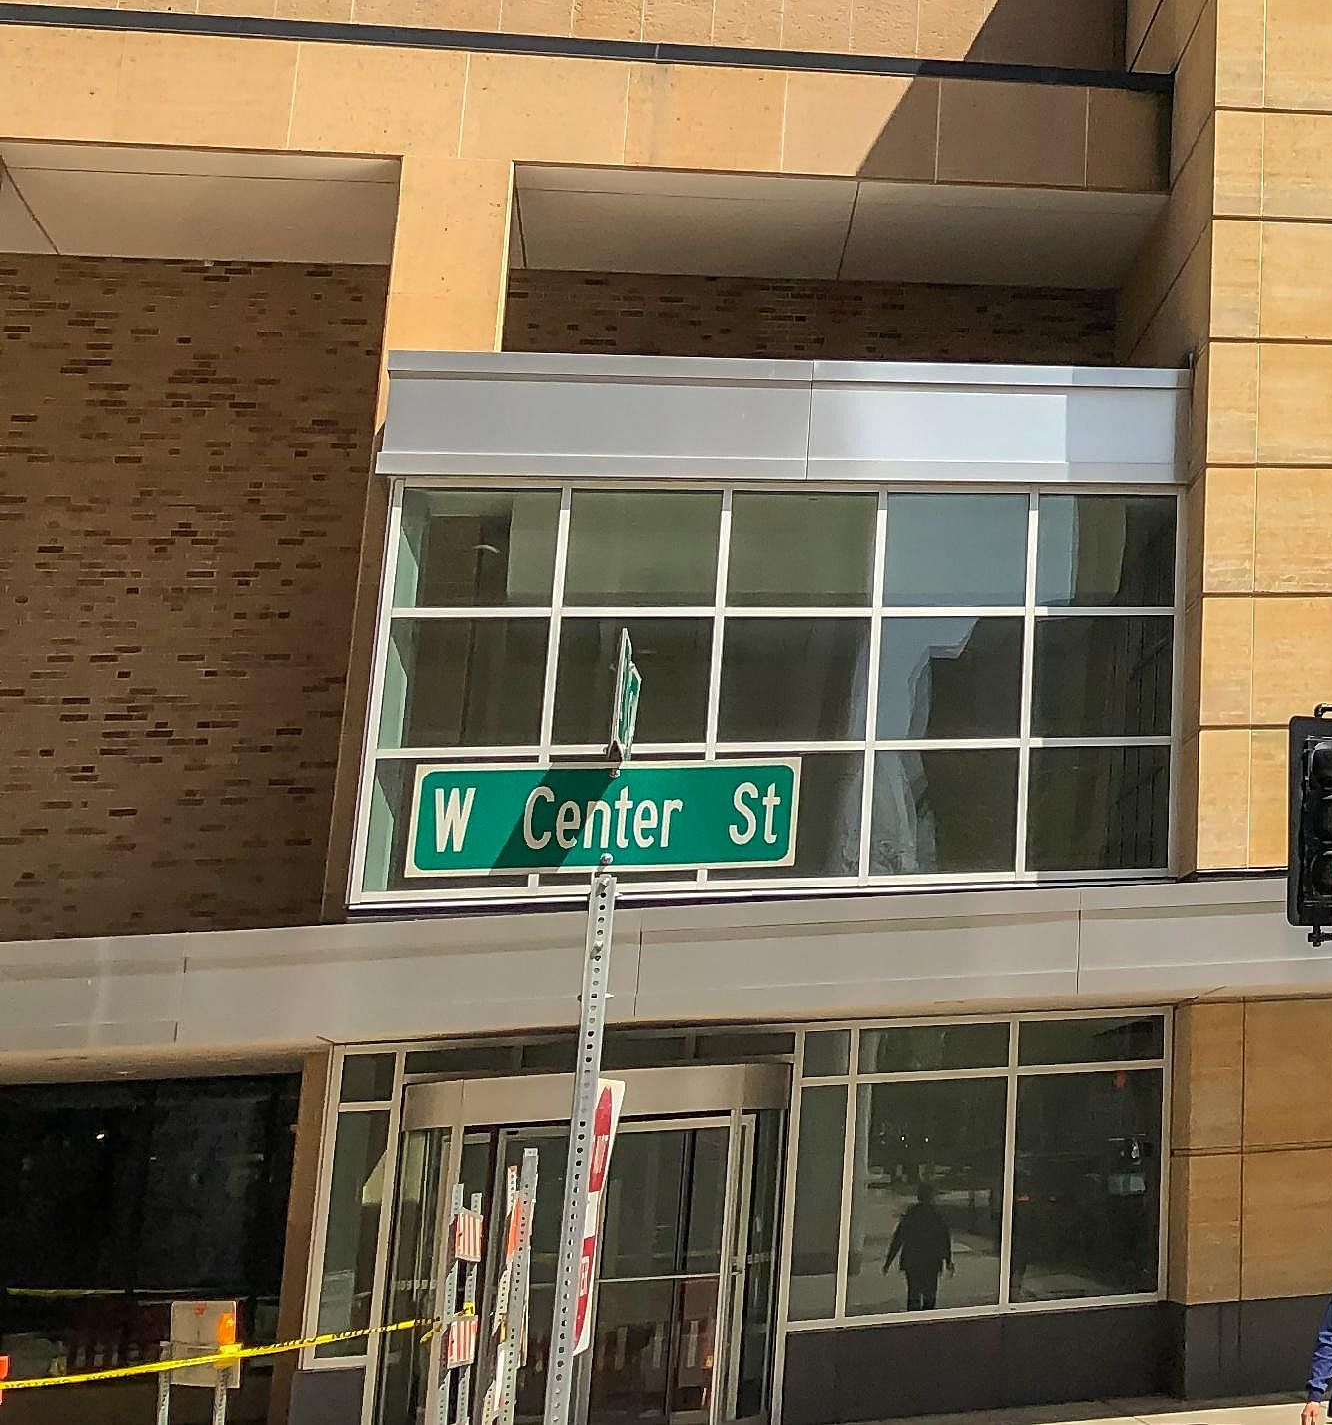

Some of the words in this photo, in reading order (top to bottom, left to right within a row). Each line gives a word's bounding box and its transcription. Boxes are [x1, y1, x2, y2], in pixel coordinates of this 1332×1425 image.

[434, 787, 477, 853] W
[523, 785, 684, 850] Center
[728, 781, 782, 846] St
